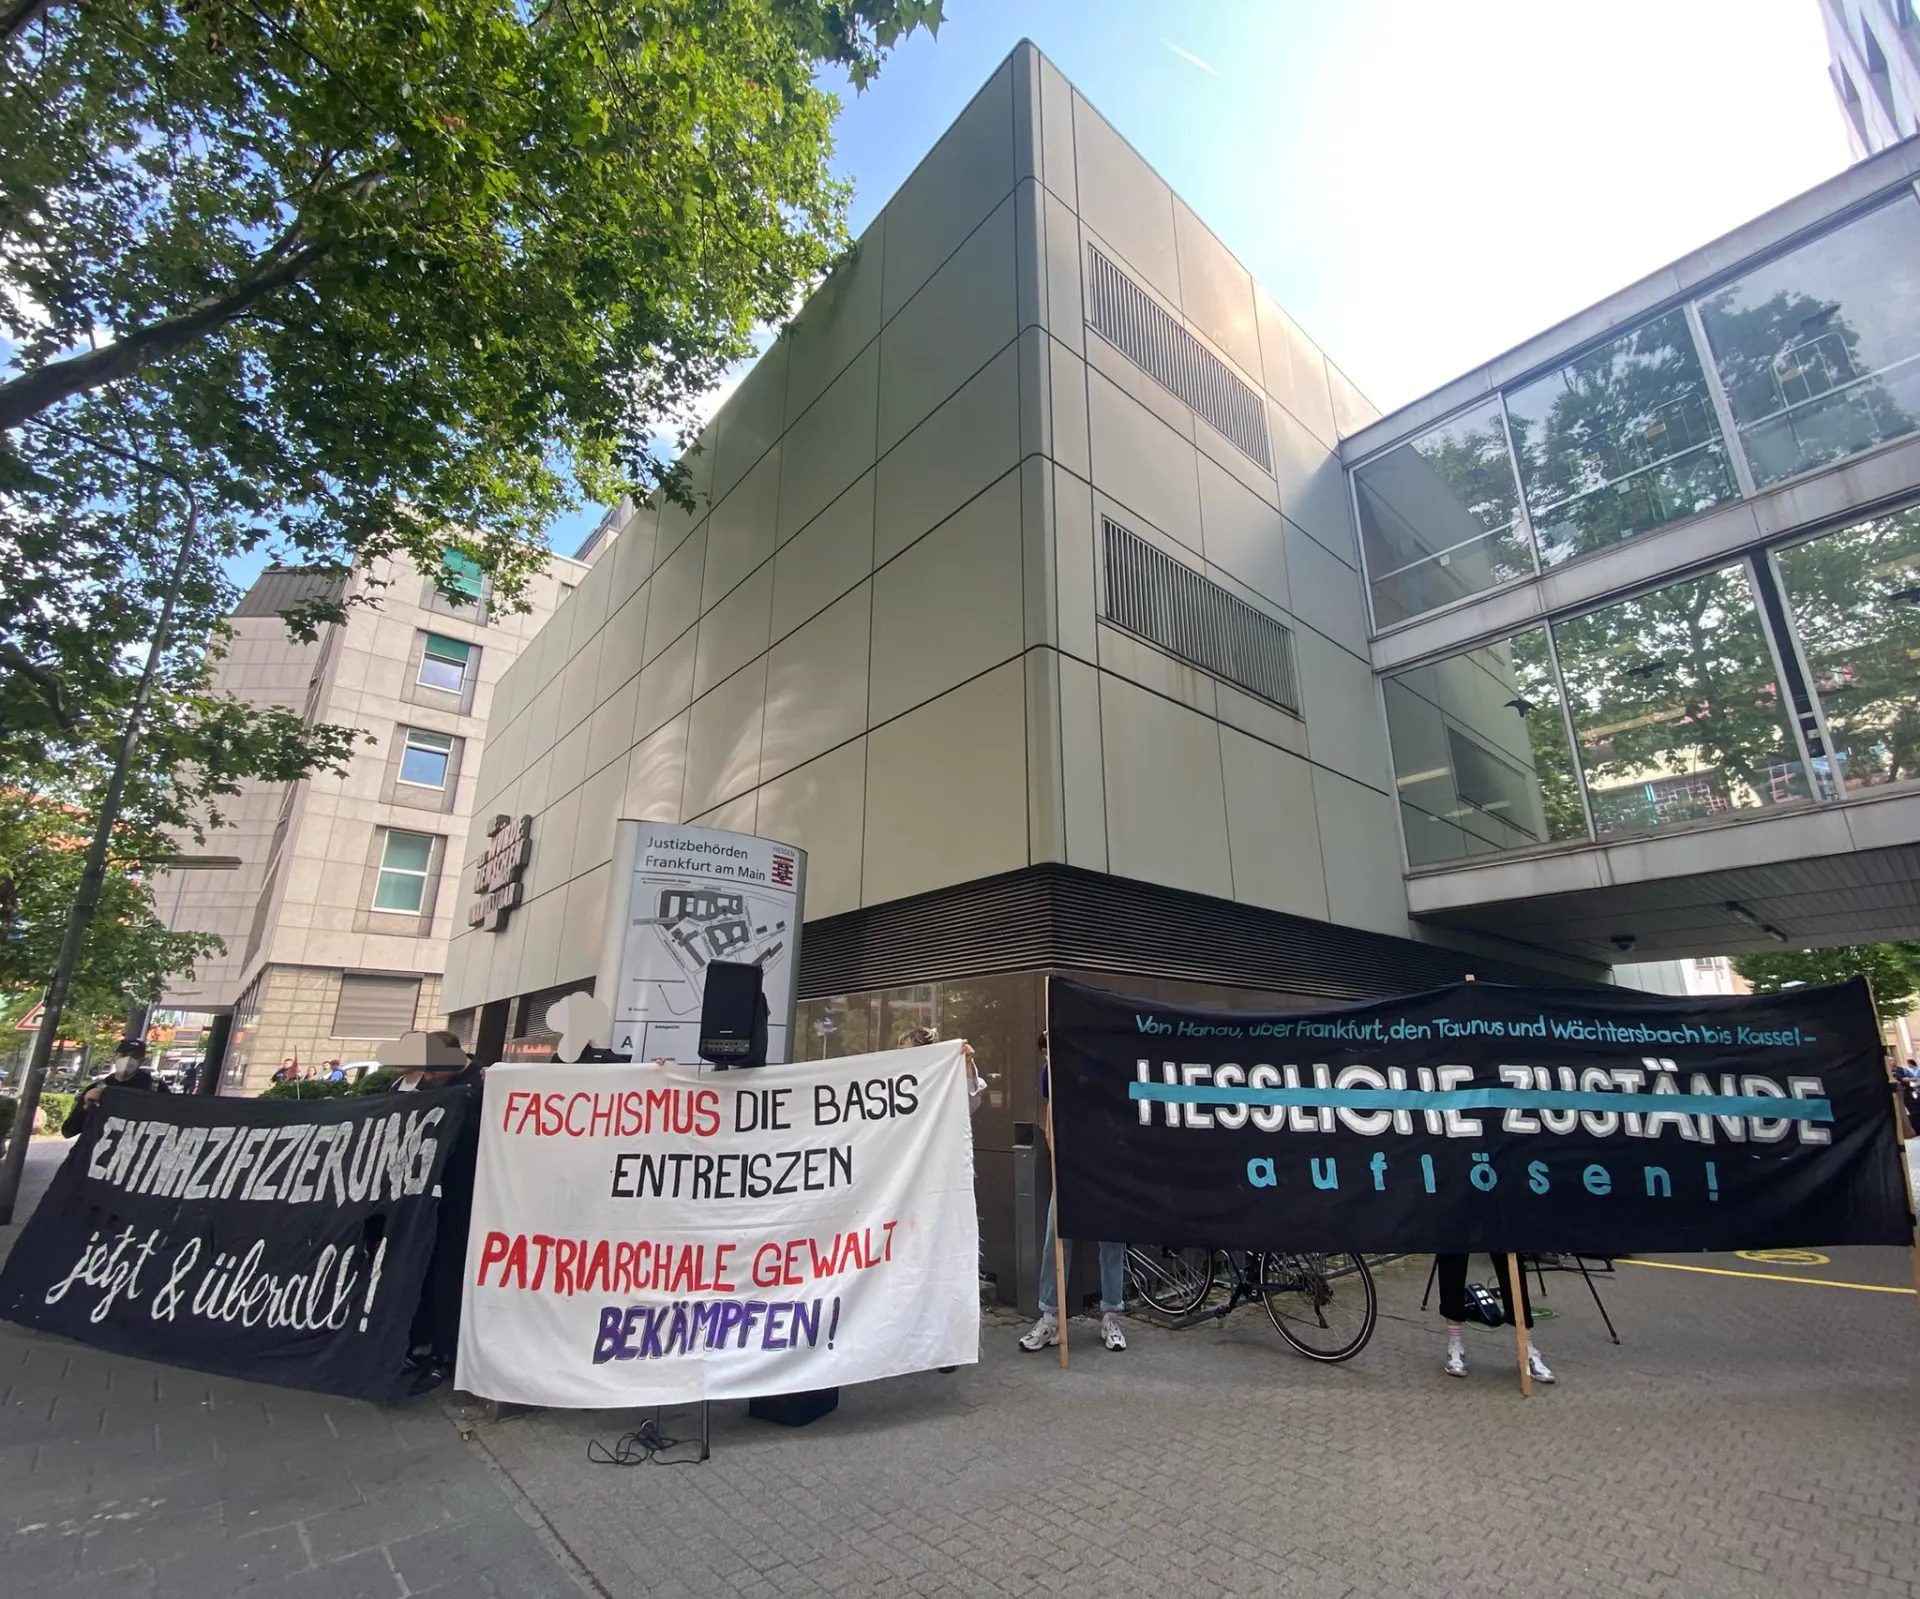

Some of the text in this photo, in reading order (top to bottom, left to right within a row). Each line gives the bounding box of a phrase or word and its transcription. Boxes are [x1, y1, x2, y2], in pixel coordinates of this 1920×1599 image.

[645, 855, 766, 881] Frankfurt am Main
[647, 837, 748, 860] Justizbehörden
[620, 1035, 634, 1049] A
[1136, 1014, 1172, 1036] Von
[1178, 1020, 1244, 1039] Hanau,
[1249, 1019, 1294, 1038] über
[1296, 1017, 1389, 1044] Frankfurt,
[1389, 1018, 1431, 1041] den
[1433, 1018, 1504, 1038] Taunus
[1508, 1014, 1546, 1038] und
[1550, 1018, 1699, 1045] Wächtersbach
[1703, 1025, 1732, 1046] bis
[503, 1074, 919, 1138] FASCHISMUS DIE BASIS
[1136, 1057, 1832, 1146] HESSLICHE ZUSTÄNDE
[88, 1107, 445, 1208] ENTNAZIFIZIERUNG.
[611, 1145, 853, 1200] ENTREISZEN
[45, 1224, 388, 1333] jetzt & überall!
[476, 1220, 898, 1296] PATRIARCHALE GEWALT
[592, 1296, 842, 1366] BEKÄMPFEN!
